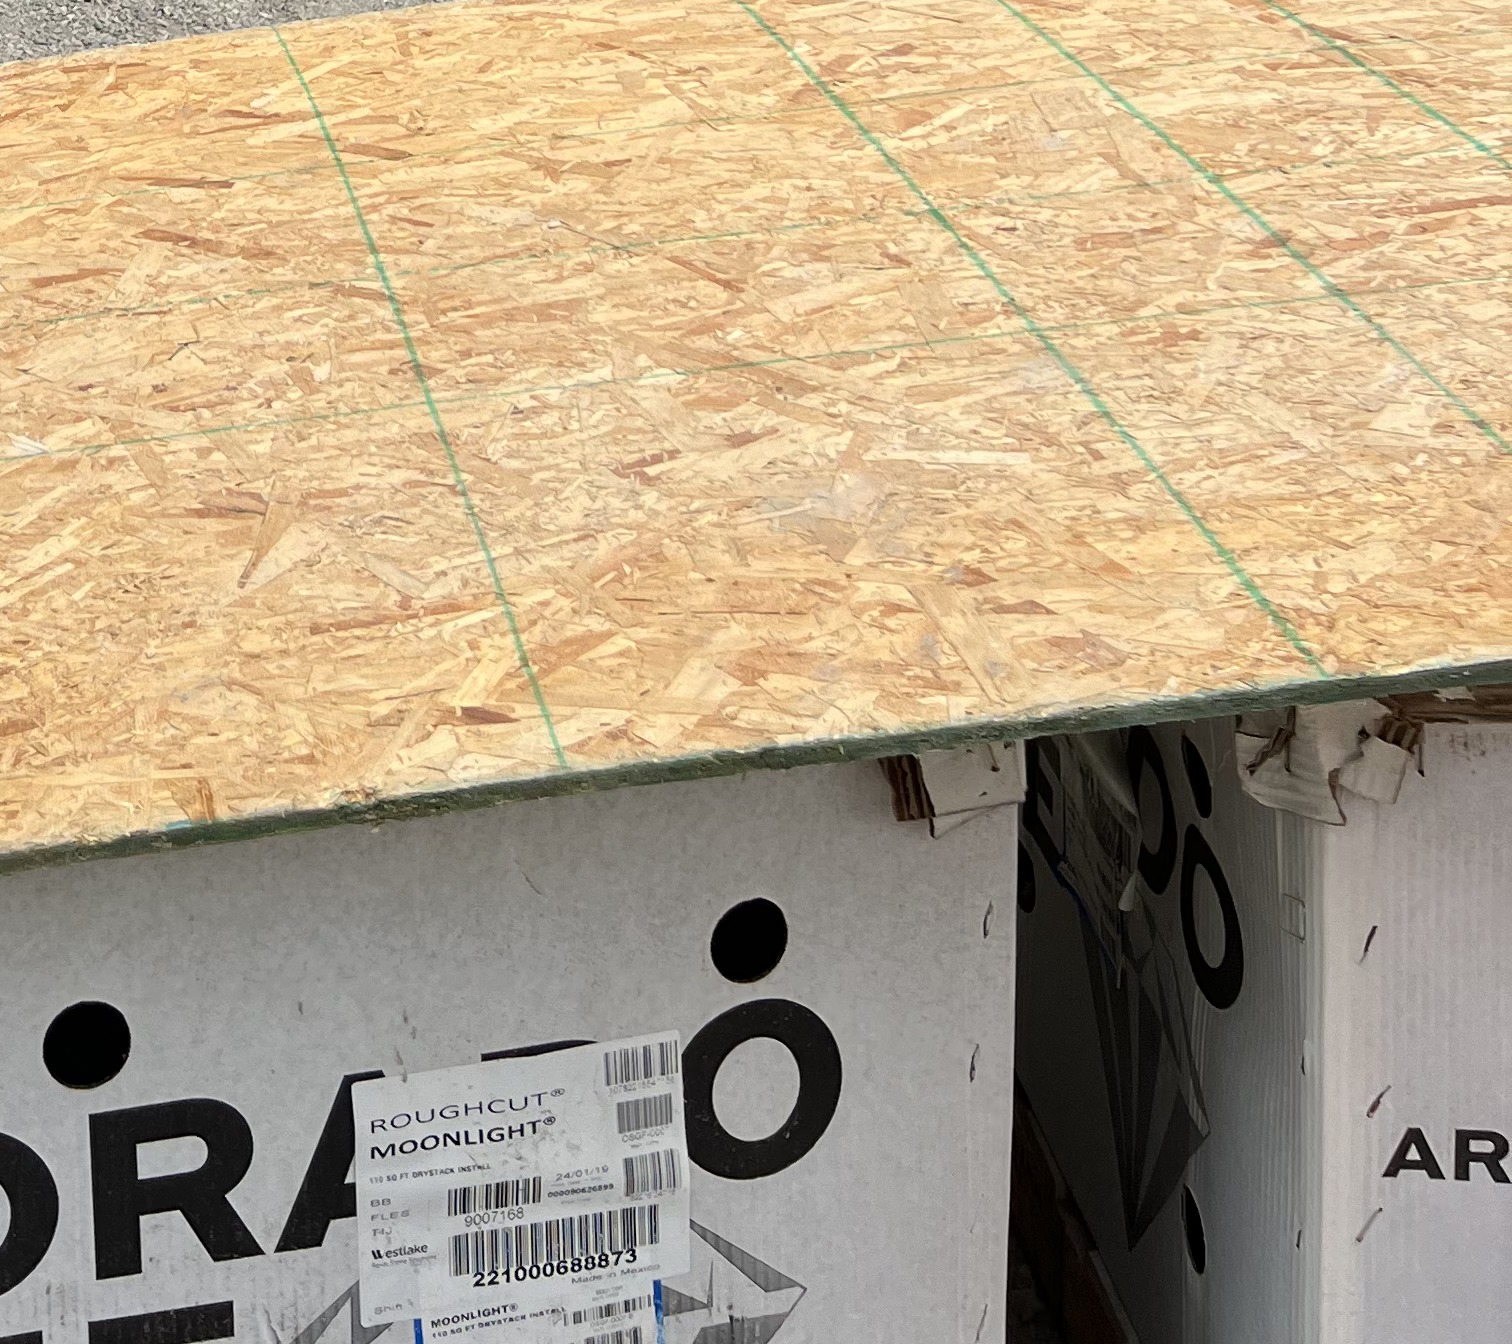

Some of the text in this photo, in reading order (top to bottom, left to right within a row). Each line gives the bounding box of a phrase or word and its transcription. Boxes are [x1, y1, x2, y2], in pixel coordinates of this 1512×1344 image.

[399, 1171, 410, 1180] FT
[412, 1166, 455, 1179] DRYSTACK
[464, 1207, 525, 1228] 9007168
[371, 1243, 429, 1260] Westlake
[472, 1248, 638, 1288] 221000688873
[571, 1263, 661, 1285] Made in Mexico
[465, 1323, 476, 1332] FT
